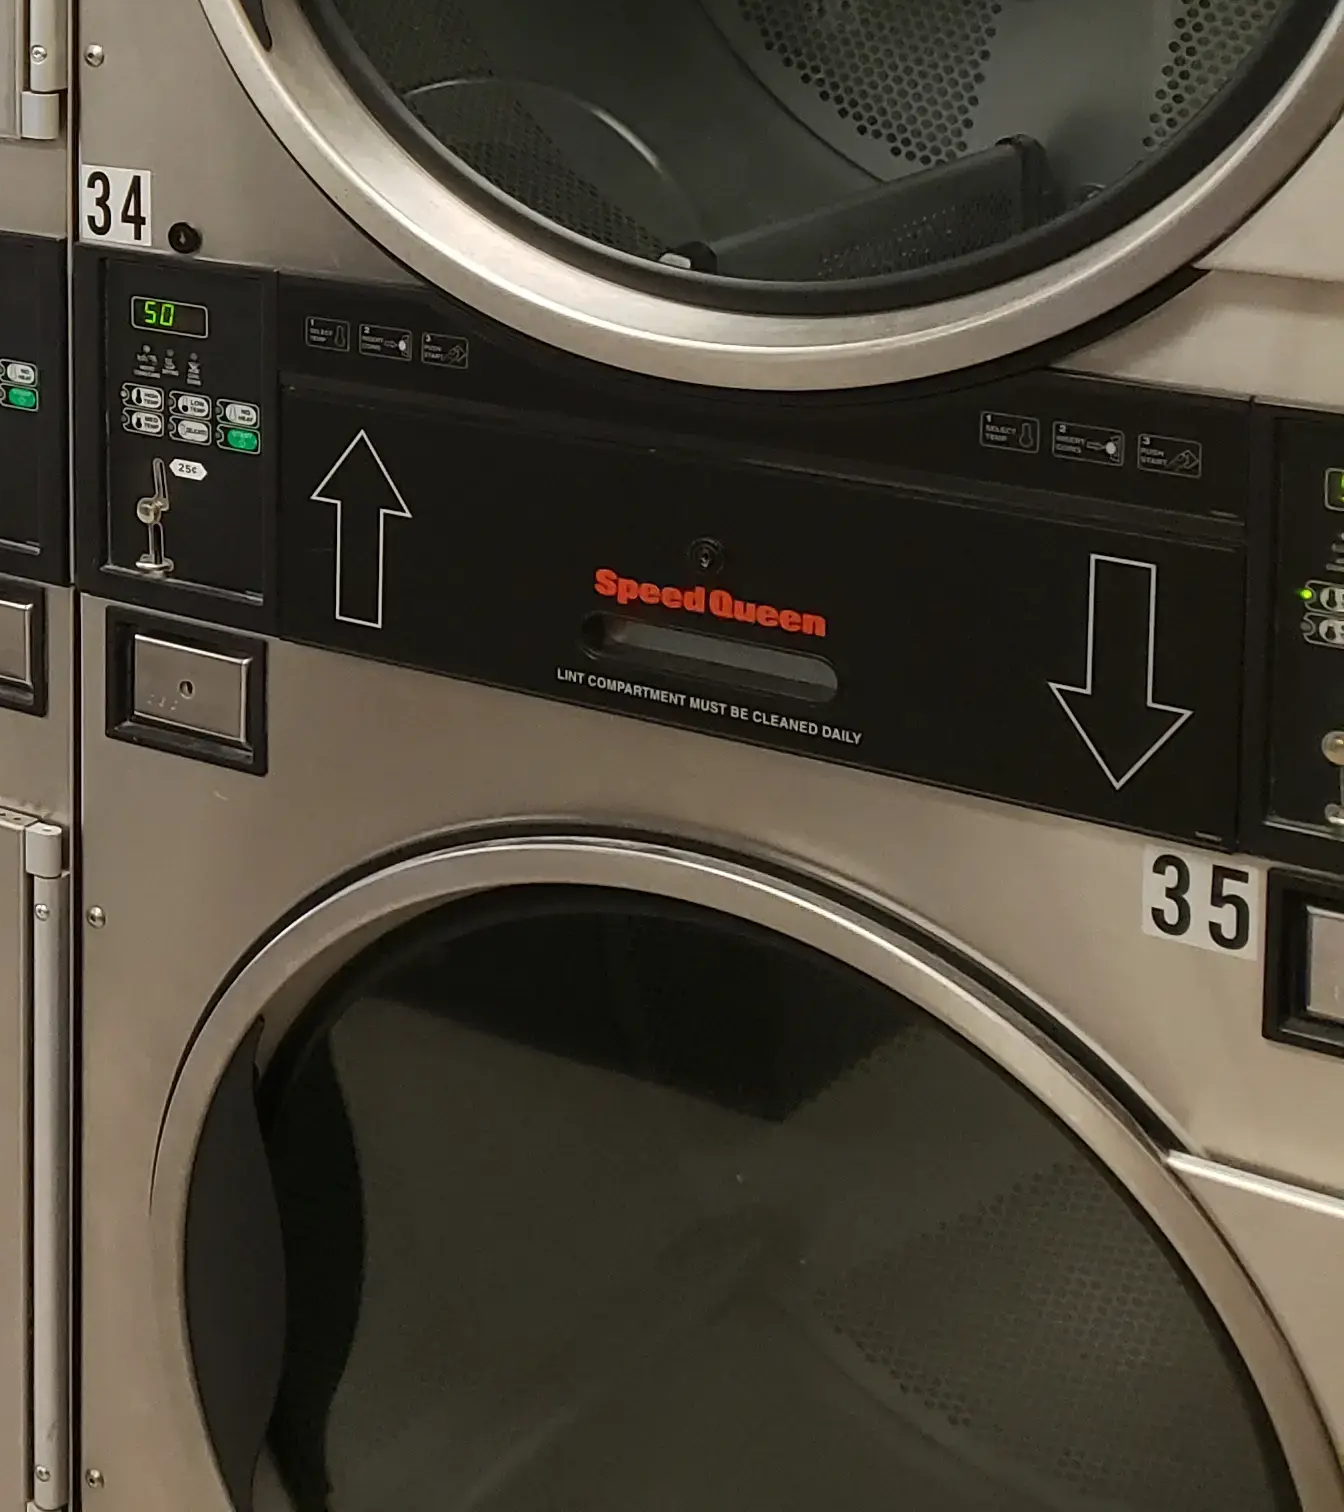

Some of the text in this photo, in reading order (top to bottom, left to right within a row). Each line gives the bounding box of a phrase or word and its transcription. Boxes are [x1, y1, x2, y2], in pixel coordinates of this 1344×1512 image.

[87, 171, 146, 240] 34
[144, 301, 175, 327] 50
[178, 463, 198, 475] 25¢
[594, 569, 827, 637] Speed Queen
[557, 667, 862, 745] LINT COMPARTMENT MUST BE CLEANED DAILY
[1151, 854, 1250, 950] 35
